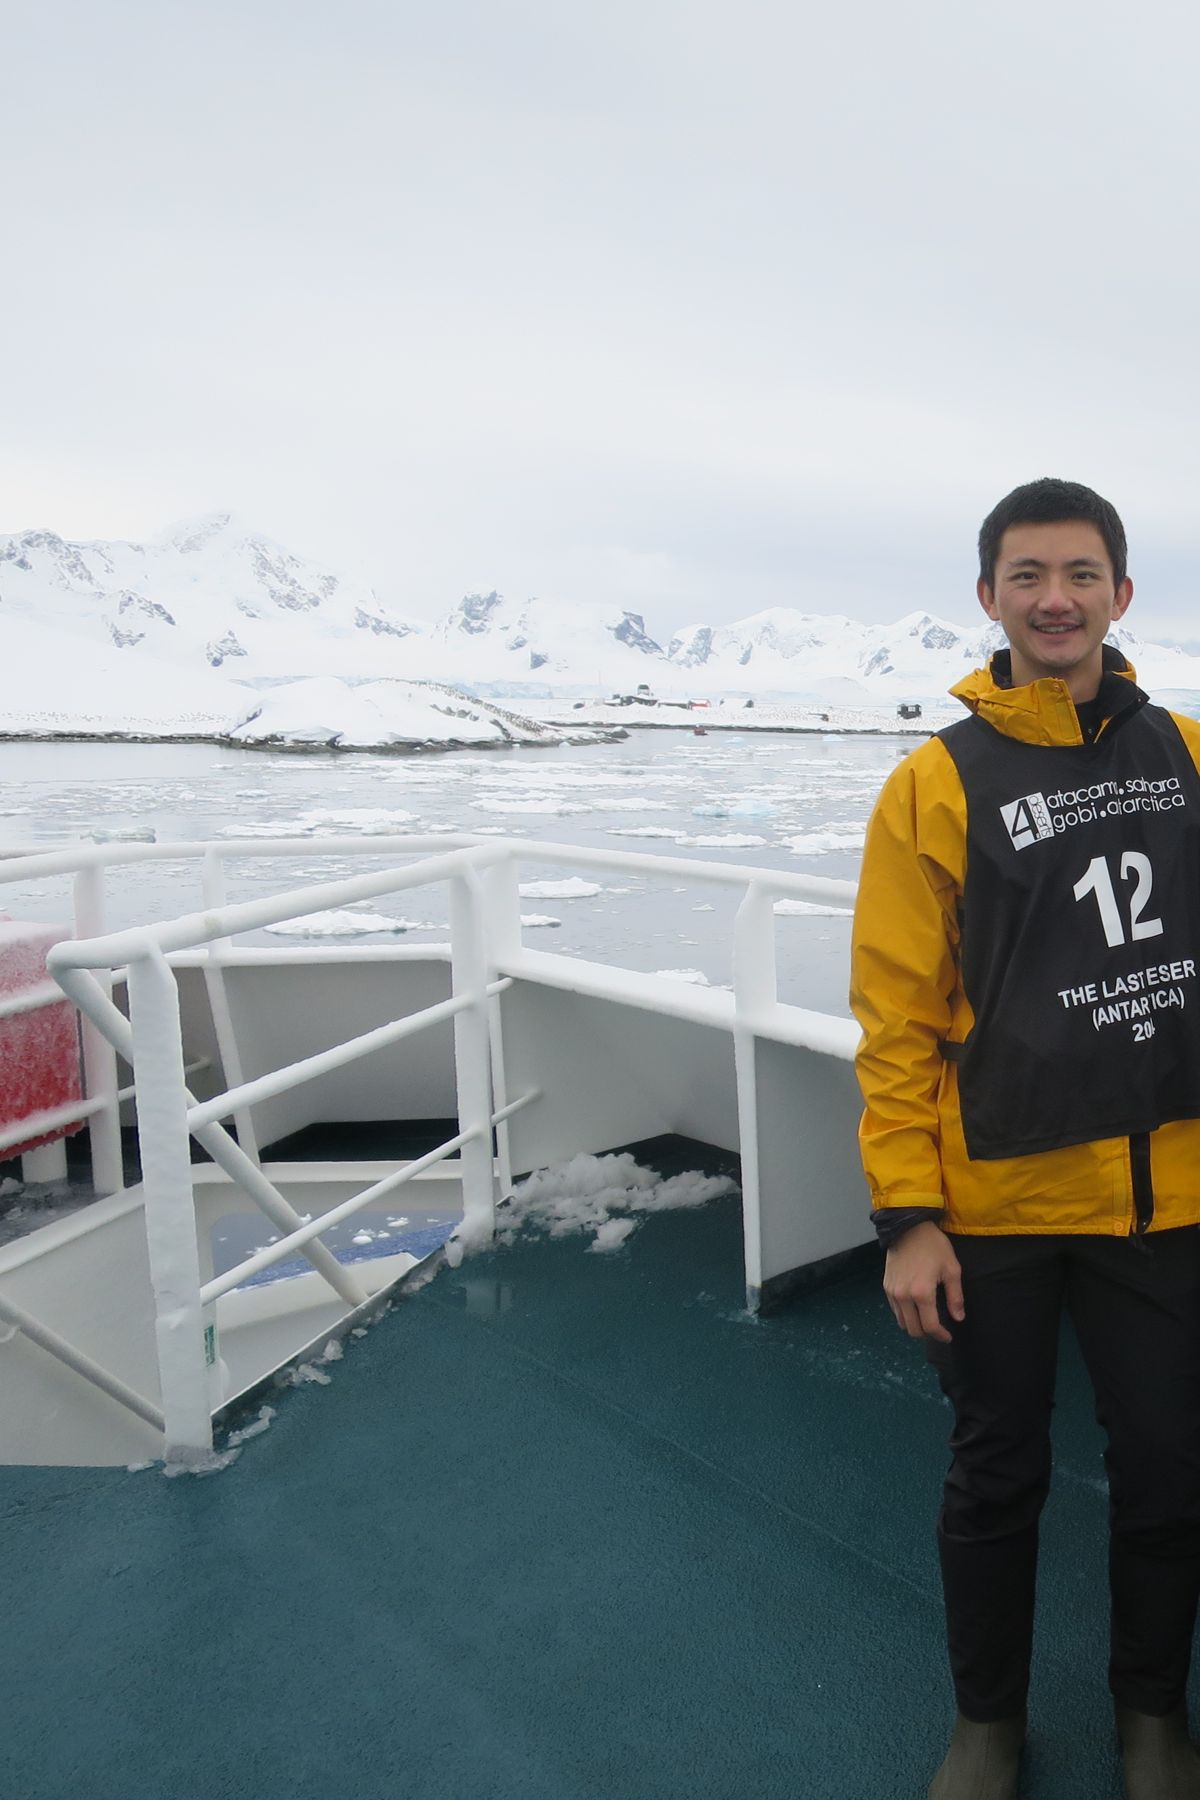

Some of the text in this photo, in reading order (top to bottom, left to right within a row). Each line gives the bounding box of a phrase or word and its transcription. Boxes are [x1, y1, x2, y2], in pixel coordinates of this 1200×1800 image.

[1046, 781, 1119, 809] atacam
[1072, 851, 1164, 948] 12
[1057, 983, 1099, 1009] THE
[1101, 971, 1145, 999] LAST
[1092, 986, 1185, 1032] (ANTARICA)
